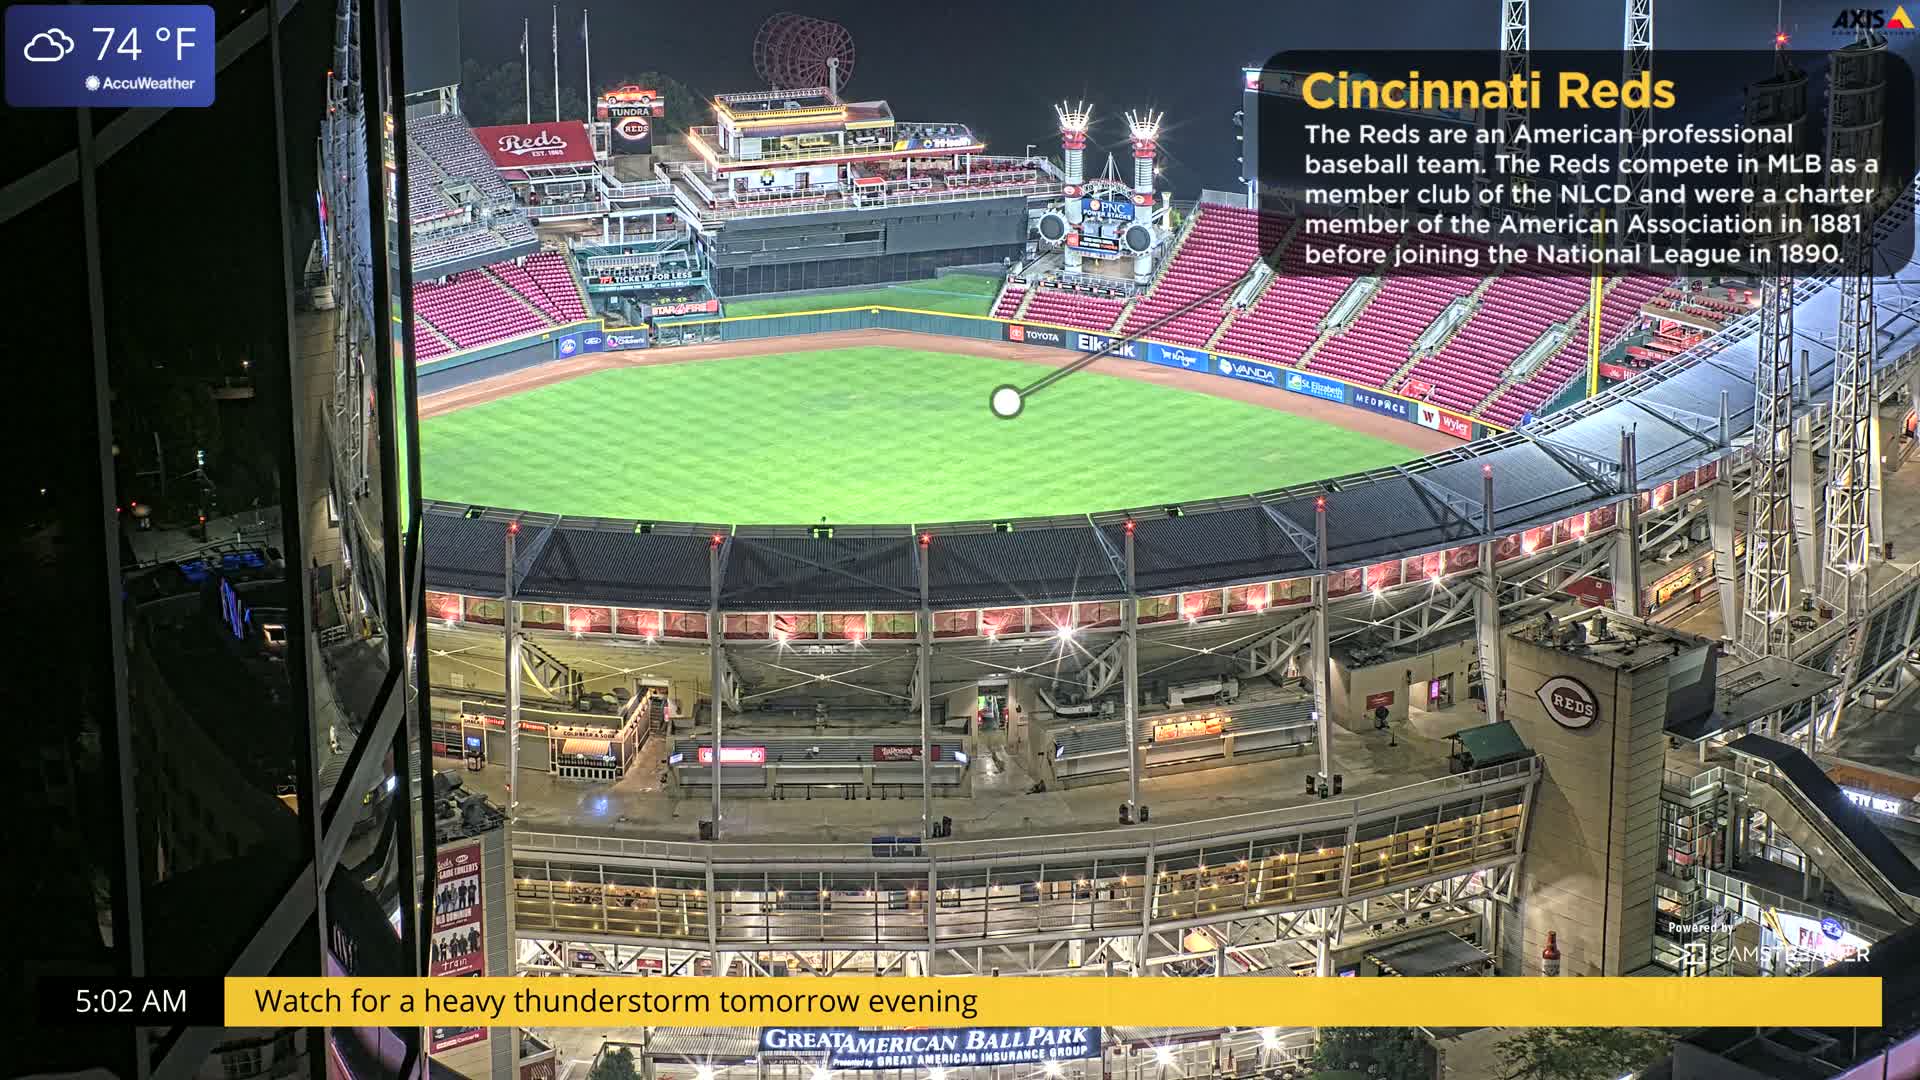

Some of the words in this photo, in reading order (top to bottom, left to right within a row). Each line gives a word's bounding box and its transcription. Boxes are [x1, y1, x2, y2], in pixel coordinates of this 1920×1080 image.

[612, 108, 650, 117] TUNDRA
[624, 125, 649, 133] REDS
[498, 130, 568, 155] Reds
[1101, 202, 1125, 214] PNC
[615, 275, 650, 284] TICKETS
[652, 272, 670, 281] FOR
[671, 270, 692, 280] LESS
[1026, 331, 1059, 342] TOYOTA
[1232, 363, 1276, 381] VANDA
[1311, 381, 1343, 396] Elizabeth
[1355, 393, 1406, 414] MEDPACE
[1423, 409, 1434, 423] W
[1443, 415, 1468, 436] Wyler
[1553, 693, 1593, 716] REDS
[441, 958, 468, 971] train
[765, 1029, 844, 1049] GREAT
[838, 1034, 957, 1054] AMERICAN
[966, 1030, 1024, 1050] BALL
[1026, 1027, 1088, 1047] PARK
[877, 1055, 912, 1067] GREAT
[917, 1052, 976, 1066] AMERICAN
[981, 1048, 1045, 1063] INSURANCE
[1050, 1045, 1088, 1058] GROUP
